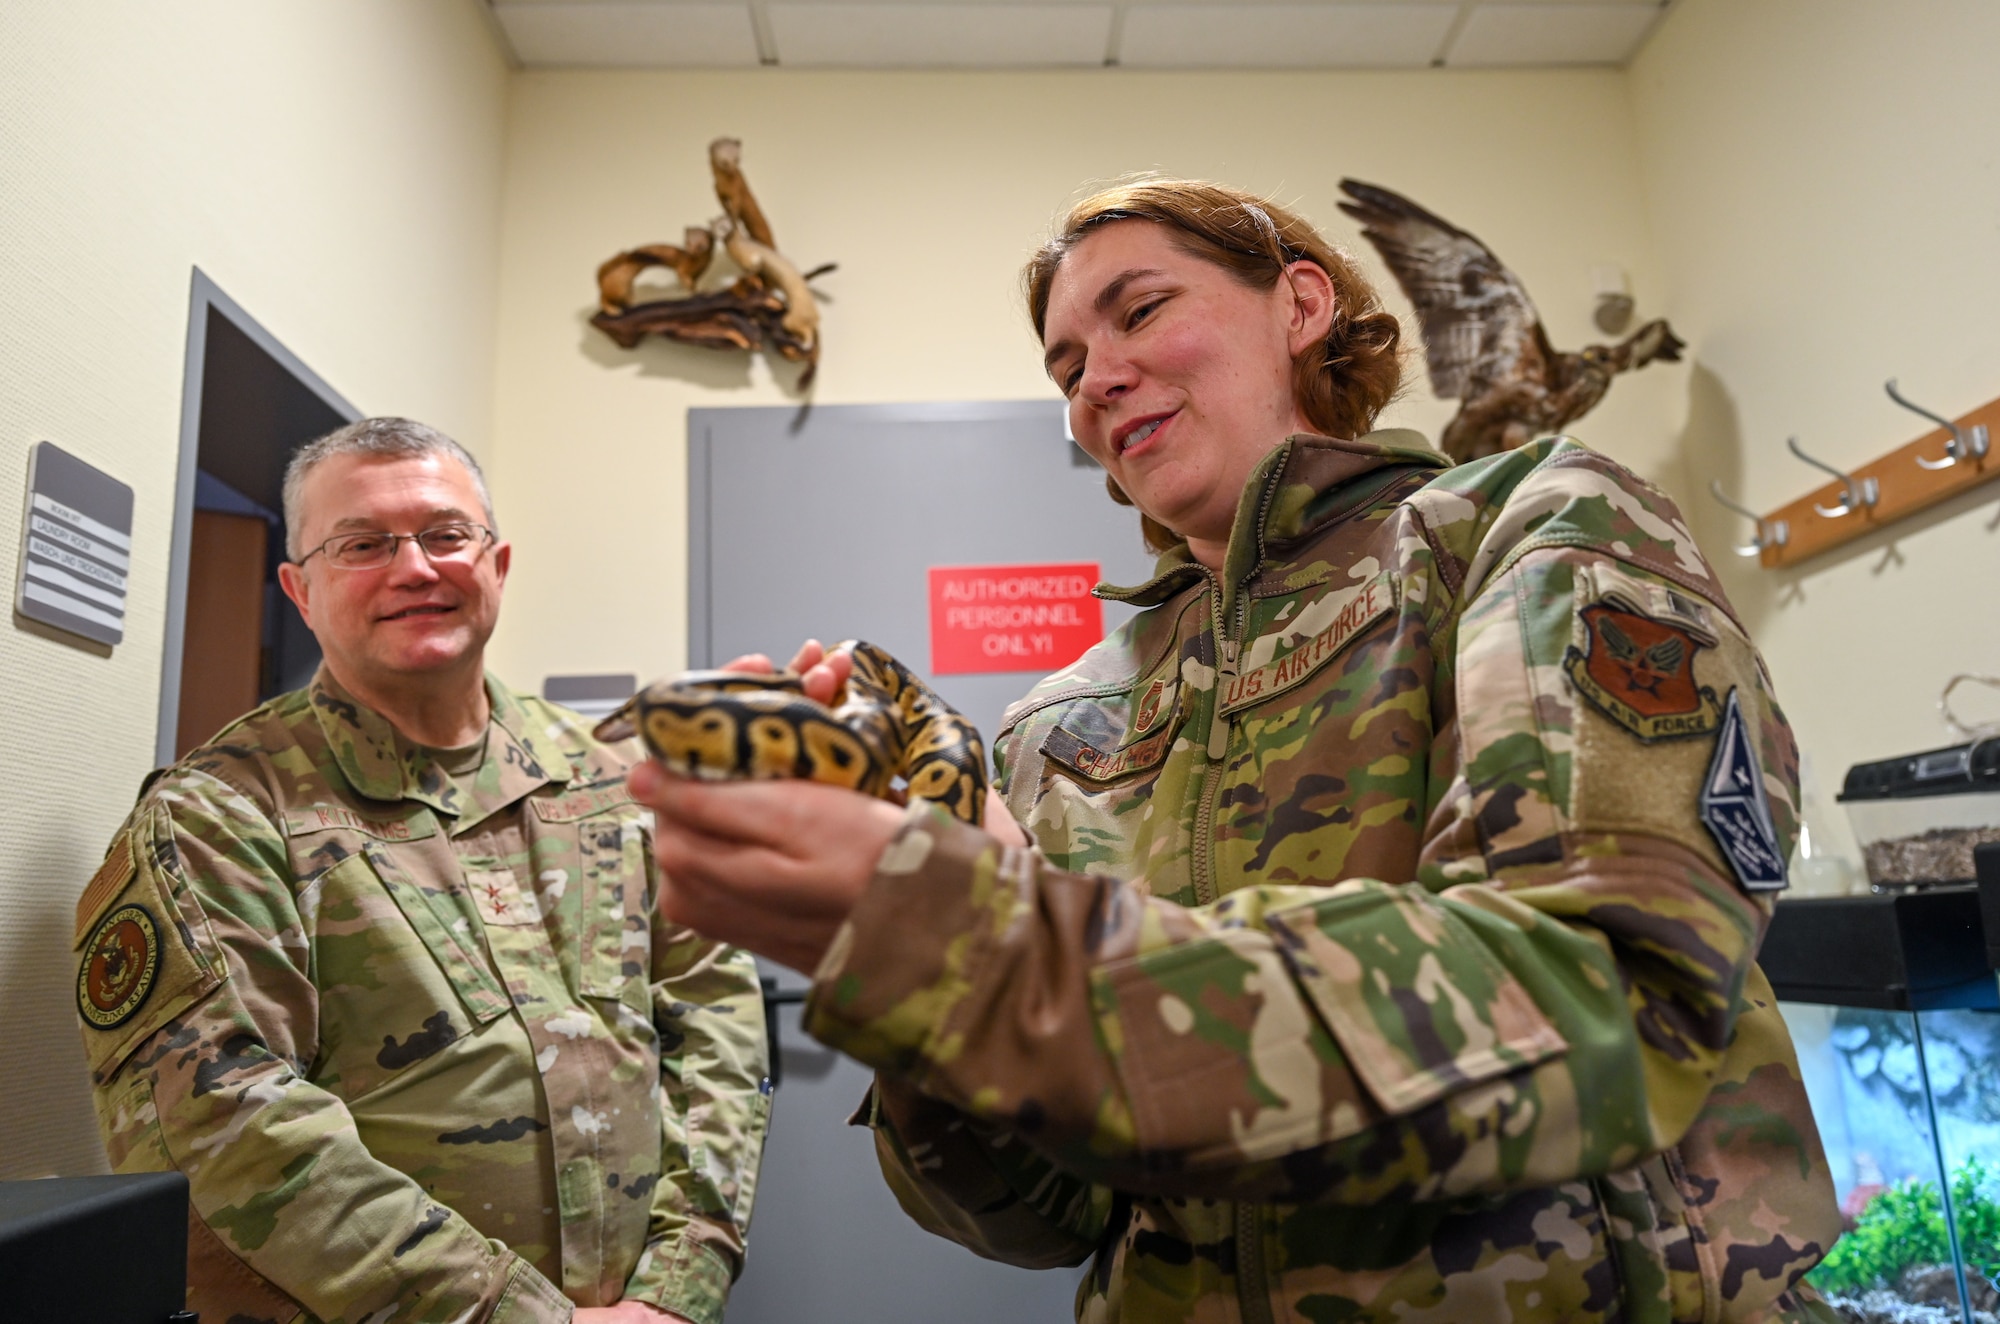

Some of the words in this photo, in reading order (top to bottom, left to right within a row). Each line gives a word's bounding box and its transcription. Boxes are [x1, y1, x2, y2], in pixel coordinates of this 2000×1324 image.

[37, 519, 69, 540] LAUNDRY
[70, 534, 92, 550] ROOM
[941, 575, 1089, 601] AUTHORIZED
[946, 603, 1085, 630] PERSONNEL
[981, 633, 1054, 657] ONLY!
[1273, 646, 1311, 688] AIR
[1314, 584, 1379, 661] FORCE
[1653, 715, 1706, 733] FORCE
